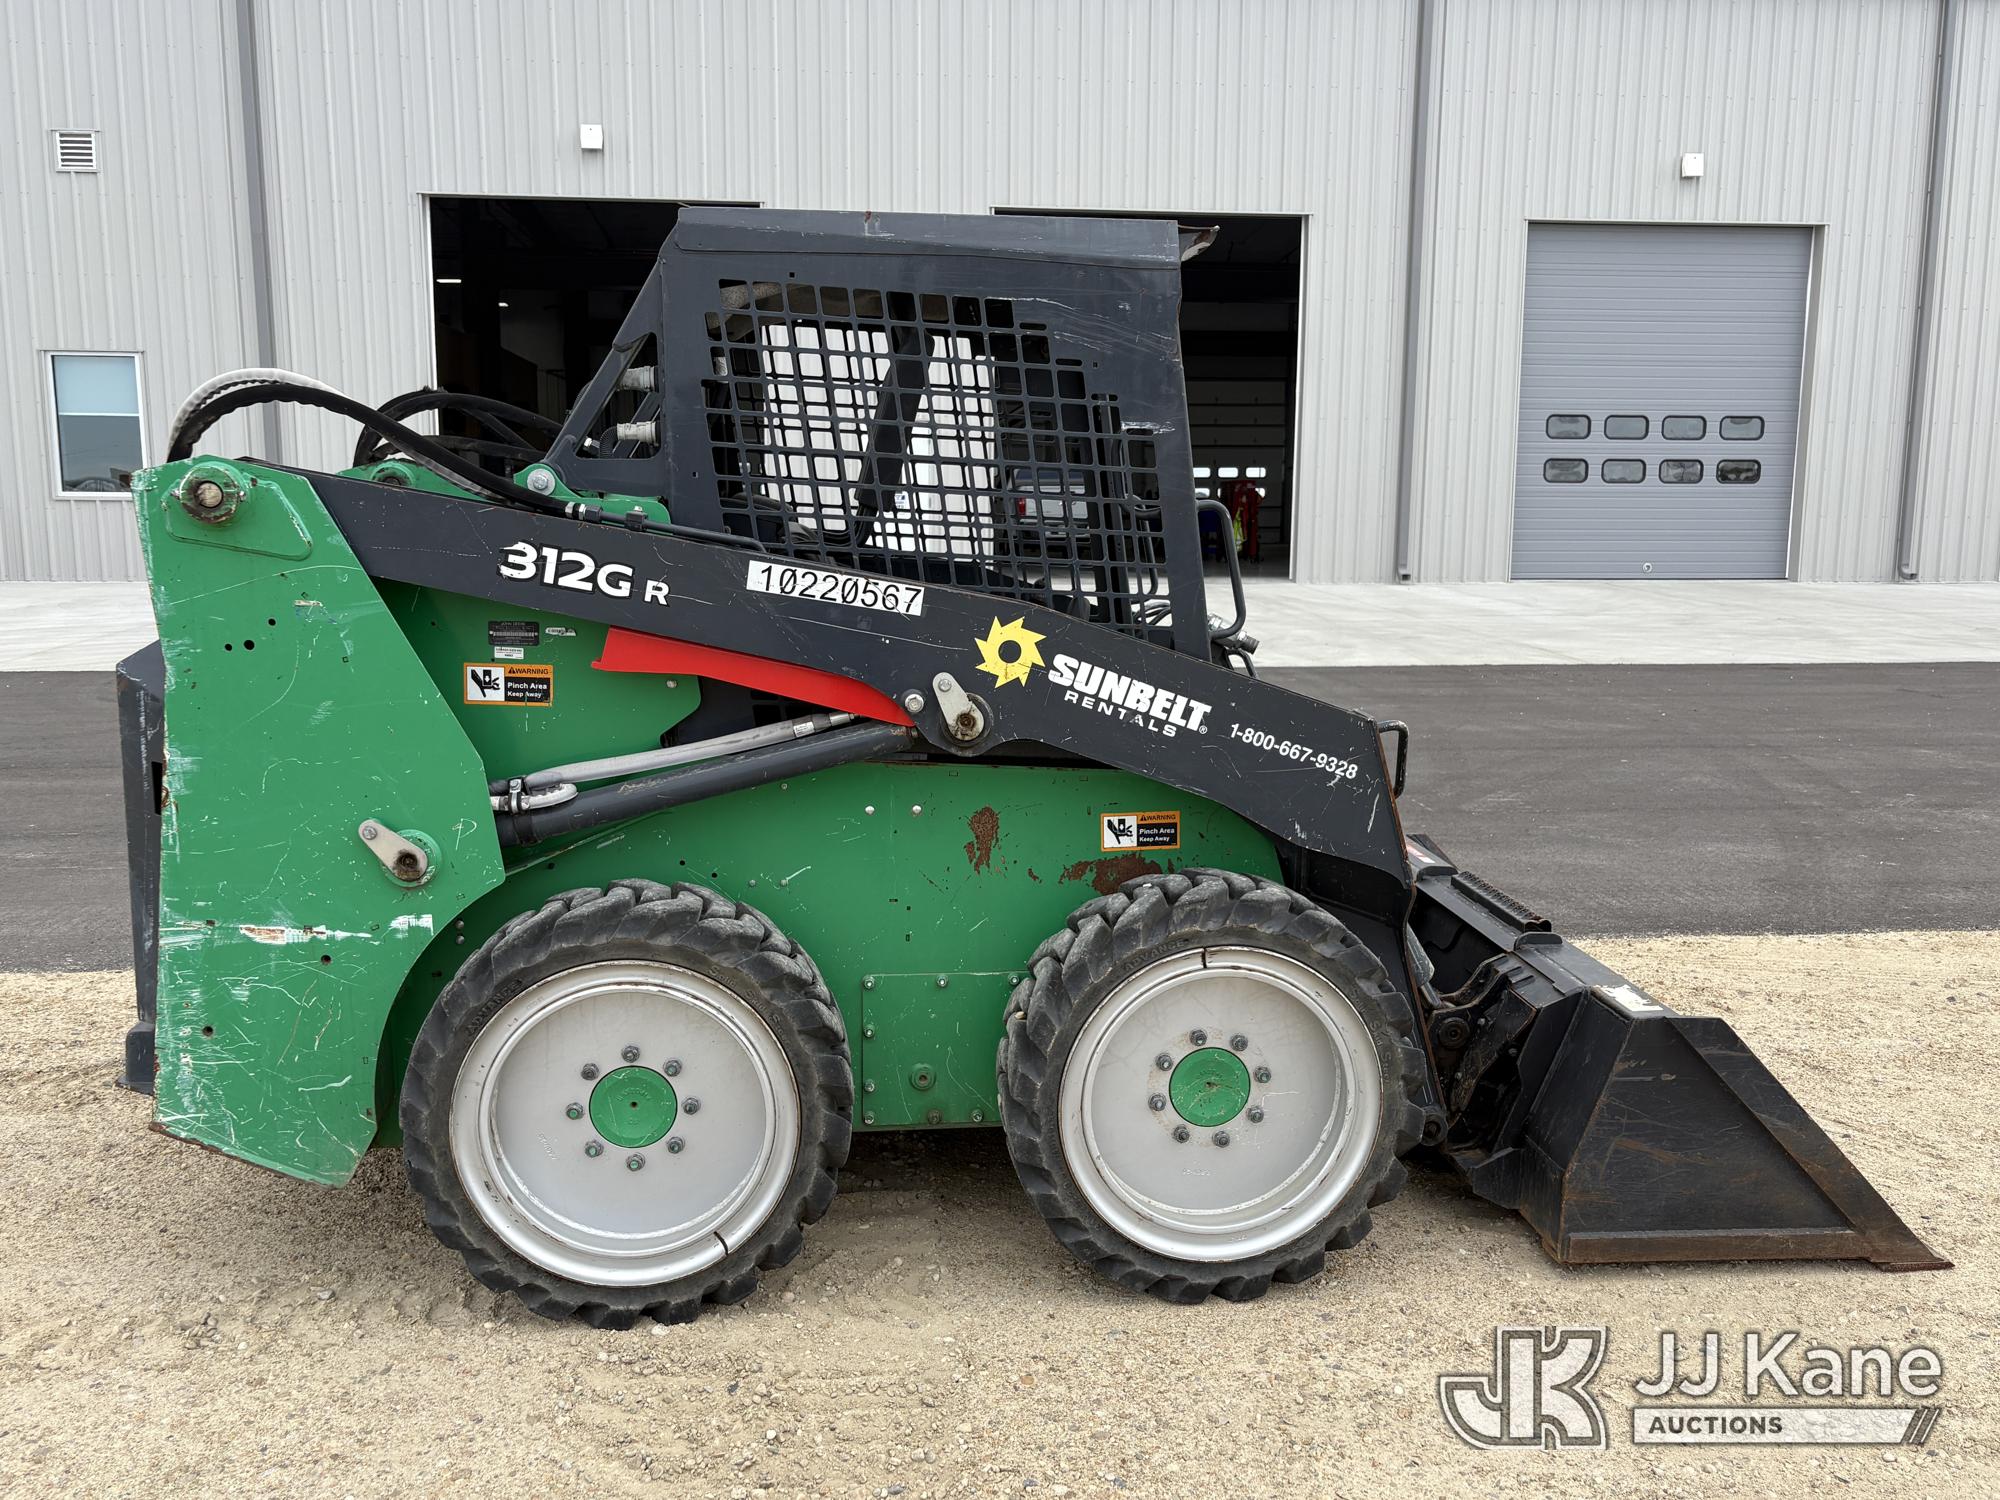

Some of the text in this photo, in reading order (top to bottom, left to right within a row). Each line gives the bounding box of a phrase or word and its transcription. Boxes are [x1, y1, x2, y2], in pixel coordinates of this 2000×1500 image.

[498, 541, 669, 605] 312G R
[761, 565, 922, 614] 10220567
[1063, 689, 1177, 738] RENTALS
[1230, 723, 1359, 781] 1-800-667-9328
[1139, 827, 1158, 835] Pinch
